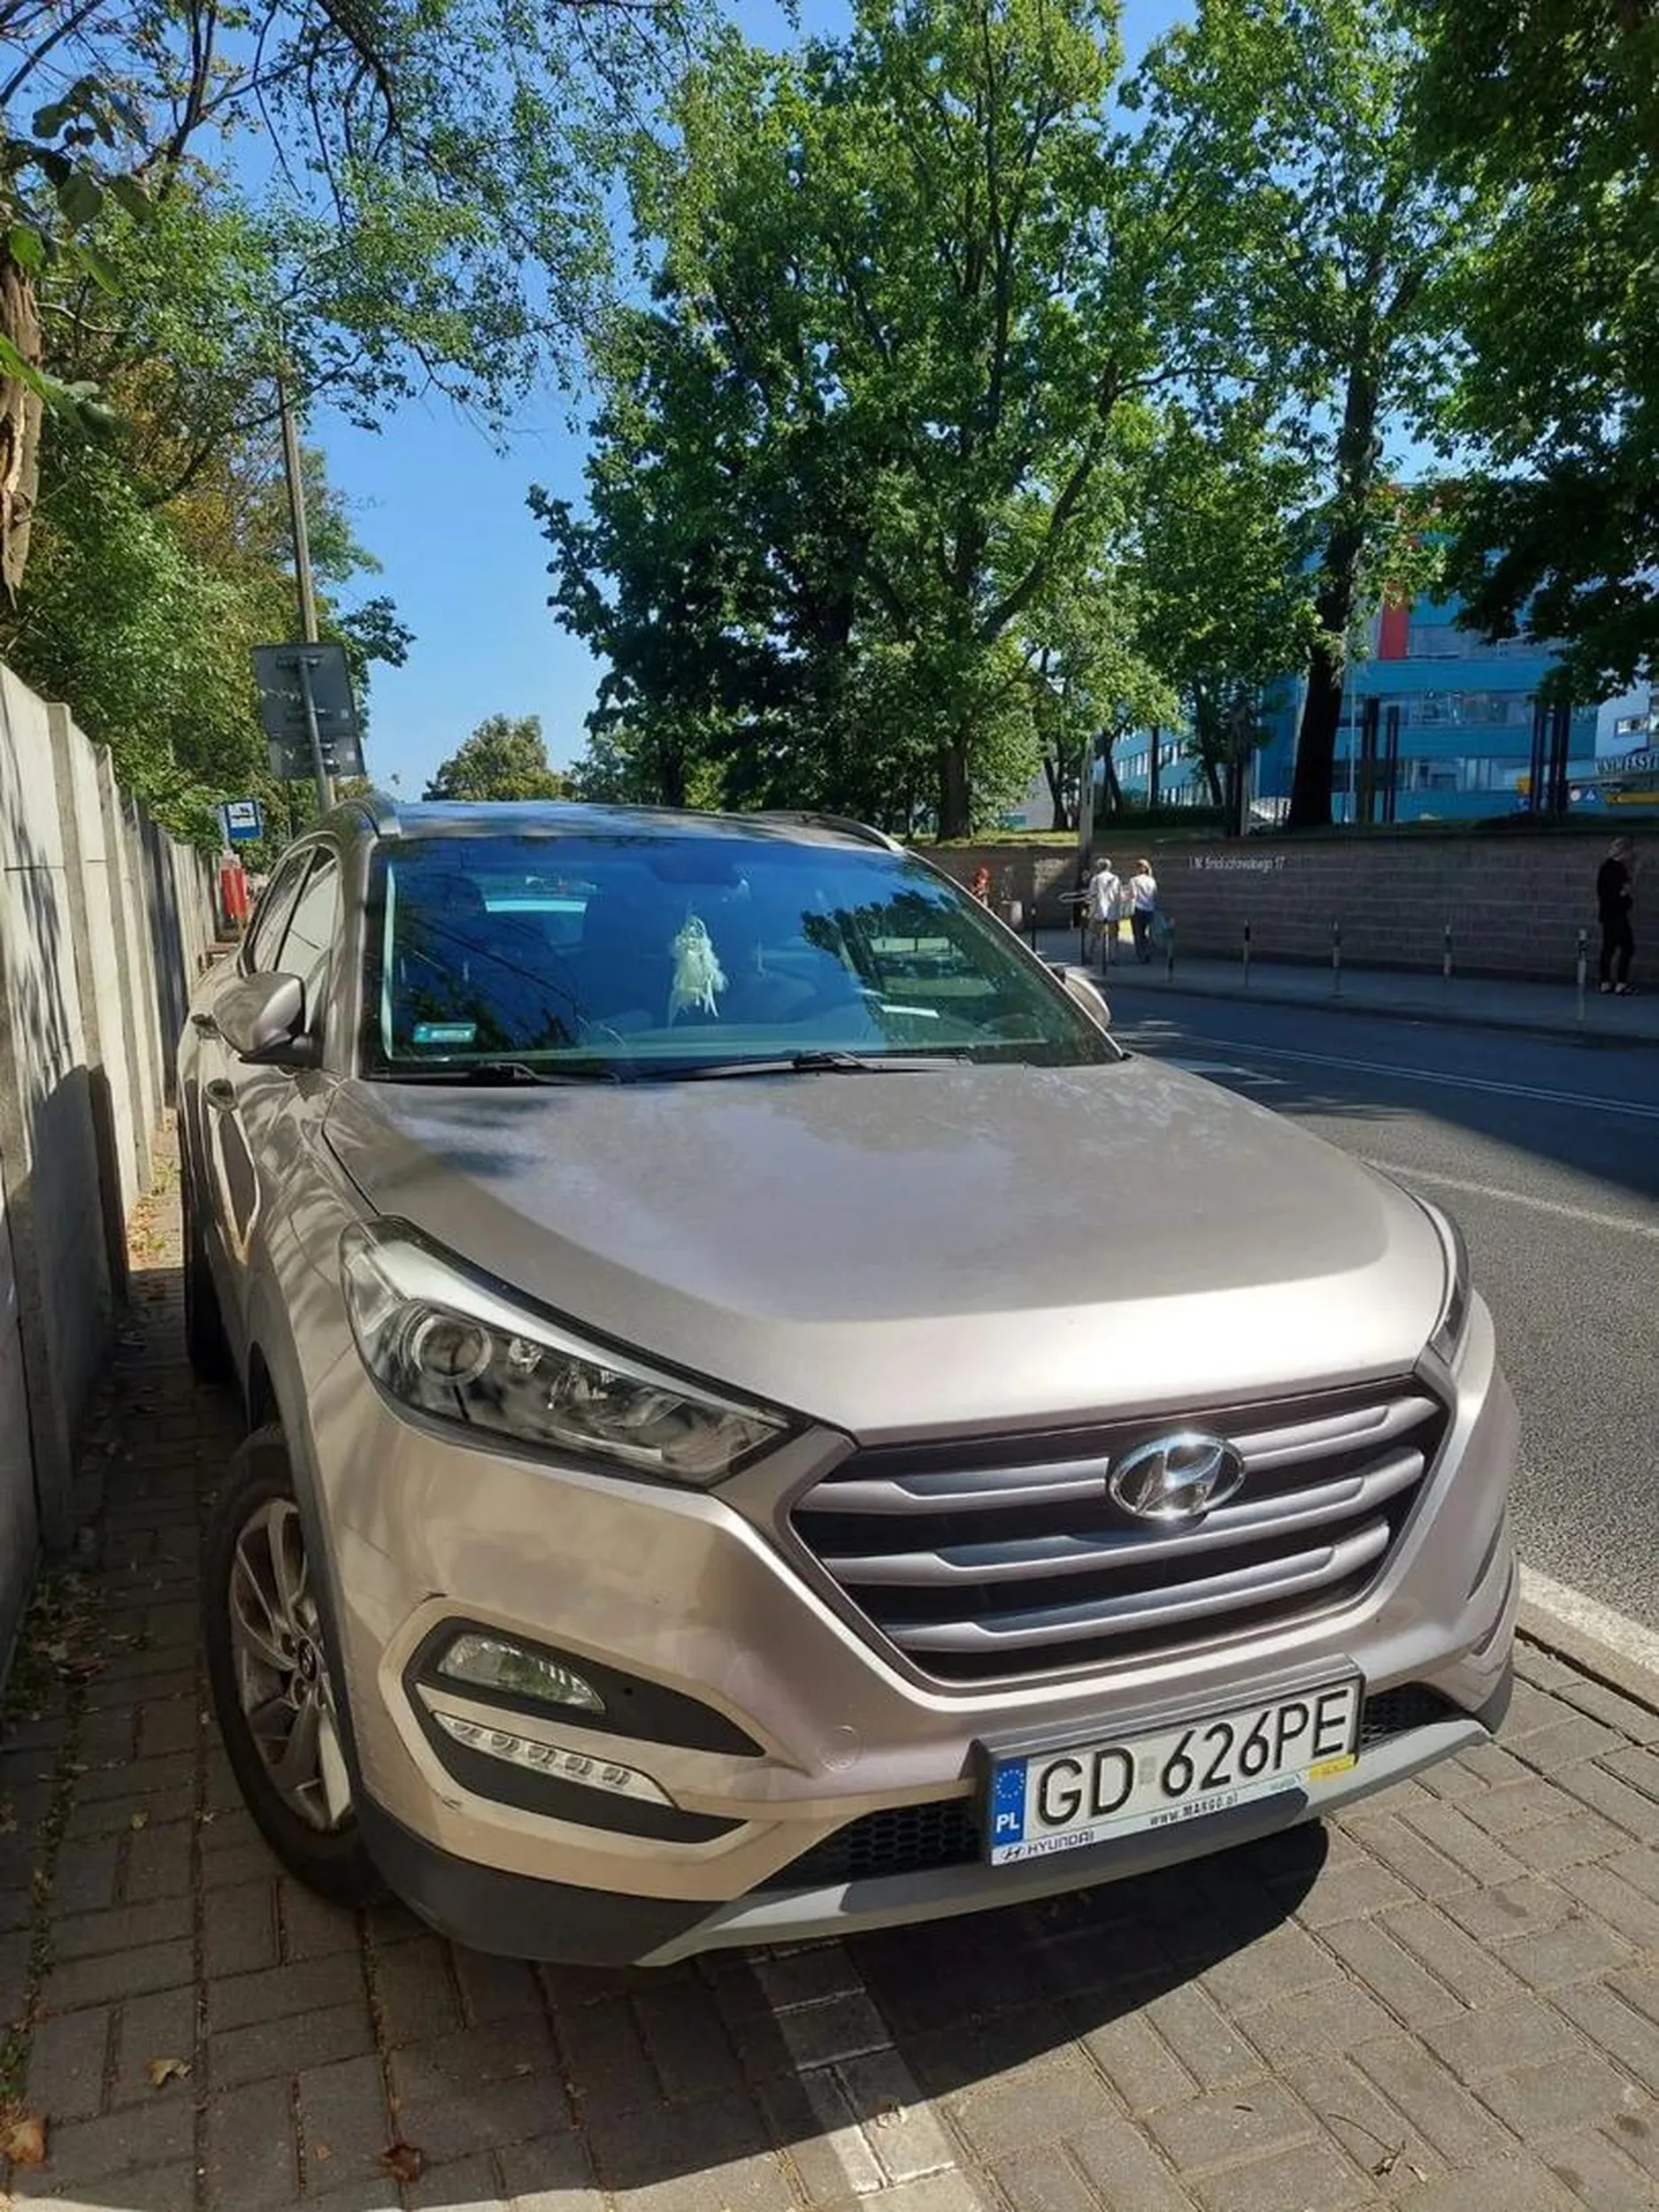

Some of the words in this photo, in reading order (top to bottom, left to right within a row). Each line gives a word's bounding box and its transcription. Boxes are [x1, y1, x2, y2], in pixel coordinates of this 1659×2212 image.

[1036, 1747, 1135, 1826] GD
[1160, 1689, 1348, 1798] 626PE
[996, 1813, 1020, 1834] PL
[1026, 1830, 1094, 1855] HYUNDAI
